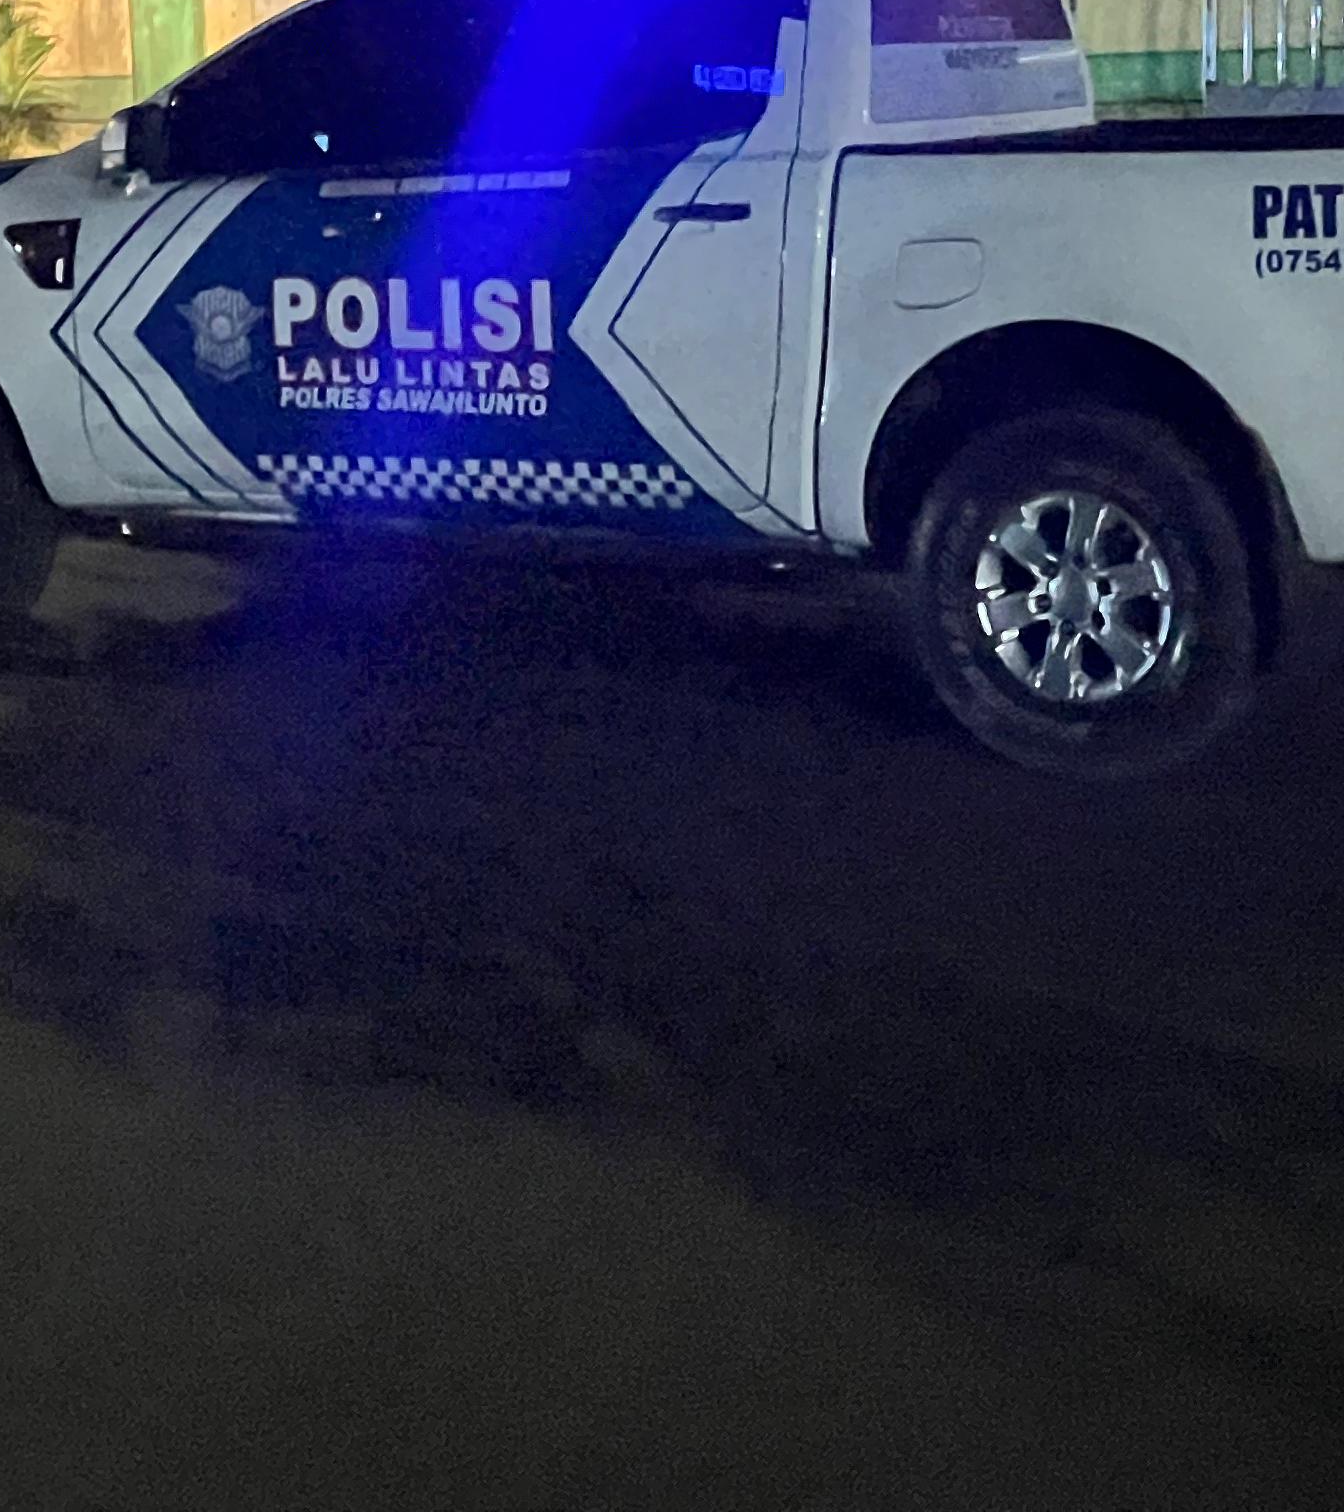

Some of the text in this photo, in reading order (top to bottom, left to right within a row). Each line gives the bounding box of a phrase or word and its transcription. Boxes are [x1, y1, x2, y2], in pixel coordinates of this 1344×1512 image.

[272, 277, 554, 352] POLISI
[277, 356, 550, 390] LALU LINTAS
[279, 386, 371, 411] POLRES
